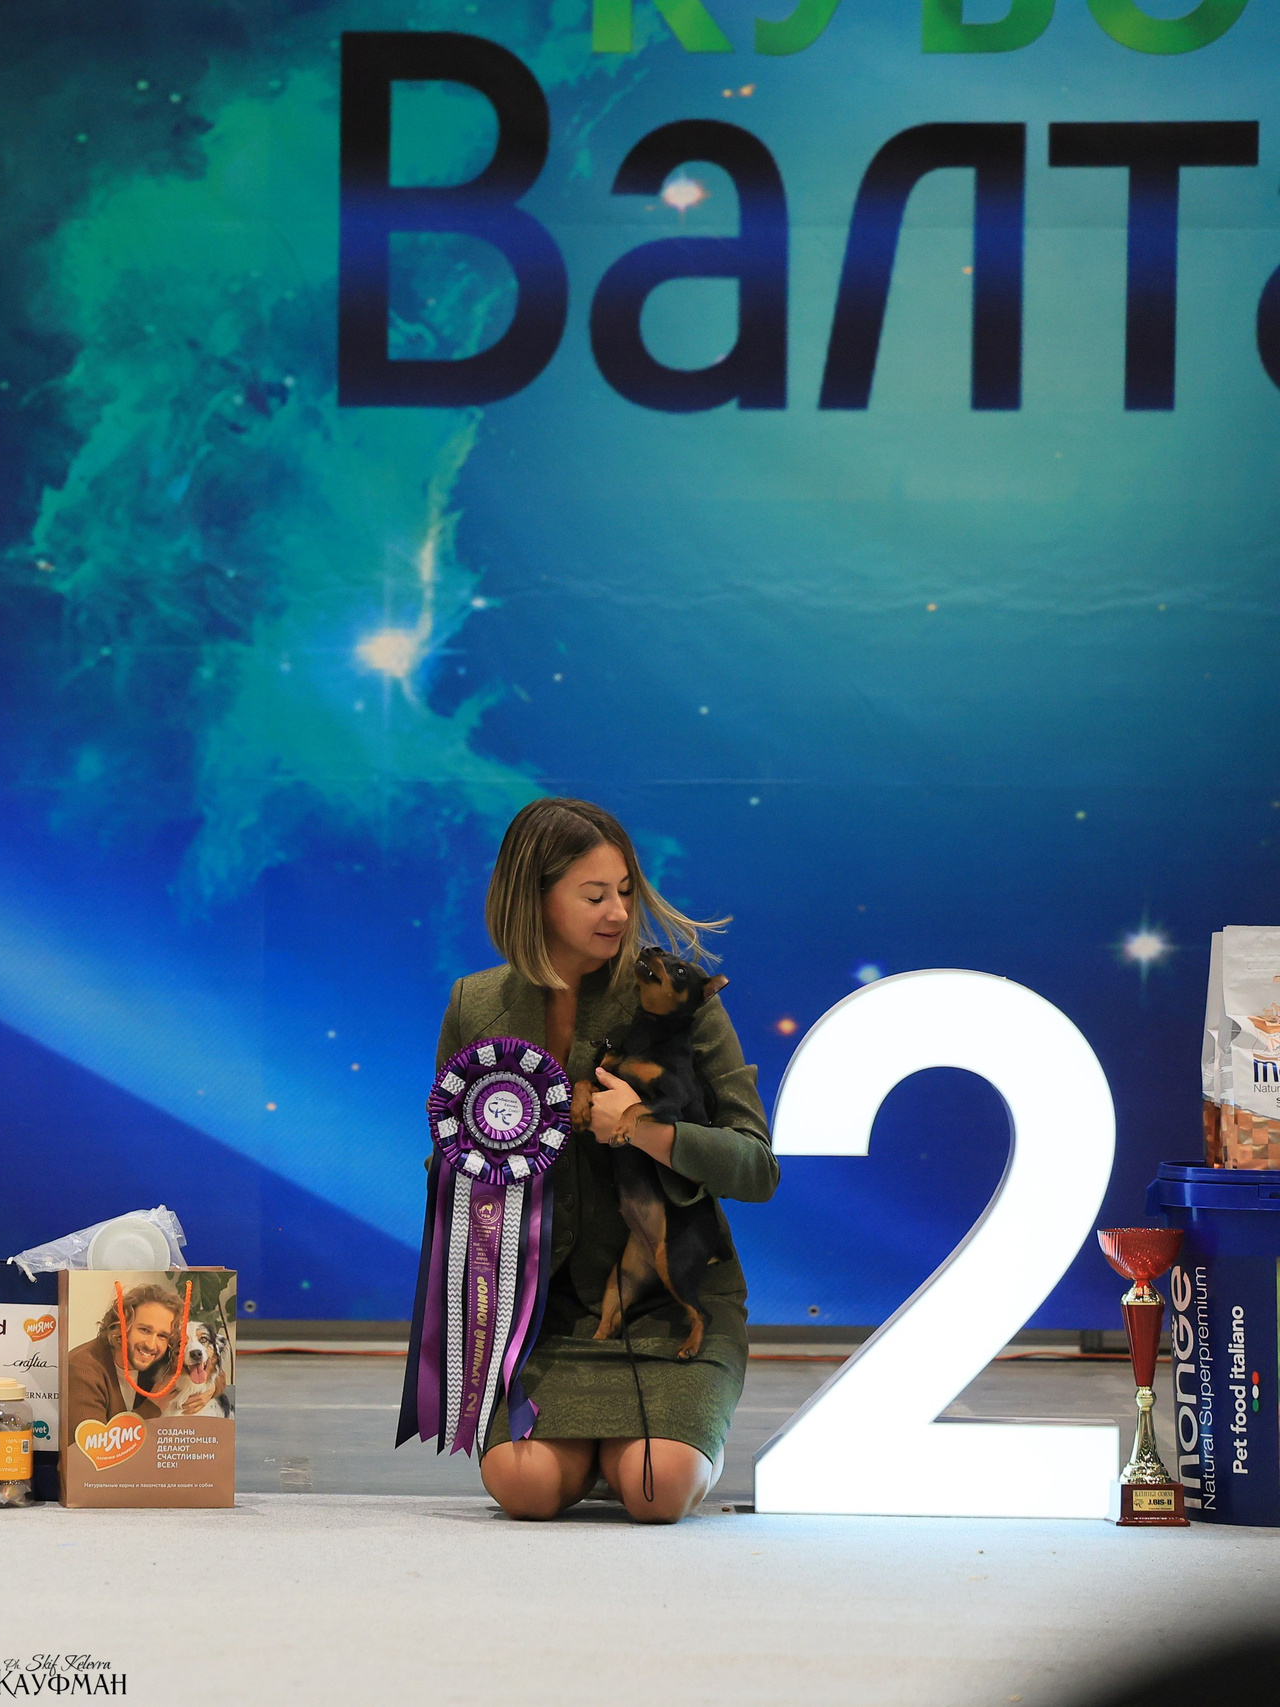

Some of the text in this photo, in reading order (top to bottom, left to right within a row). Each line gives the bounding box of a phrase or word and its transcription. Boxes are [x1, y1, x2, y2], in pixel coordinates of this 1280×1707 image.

[337, 31, 1280, 413] Валт
[753, 968, 1121, 1519] 2
[27, 1320, 54, 1334] МНЯМС
[476, 1275, 489, 1327] ЮНИОР
[471, 1328, 487, 1387] ЛУЧШИЙ
[25, 1392, 59, 1400] ERNARD
[466, 1392, 478, 1412] 2
[1193, 1265, 1217, 1511] Natural Superpremium
[1227, 1305, 1249, 1474] Pet food italiano
[33, 1425, 47, 1434] vet
[85, 1424, 142, 1452] МНЯМС
